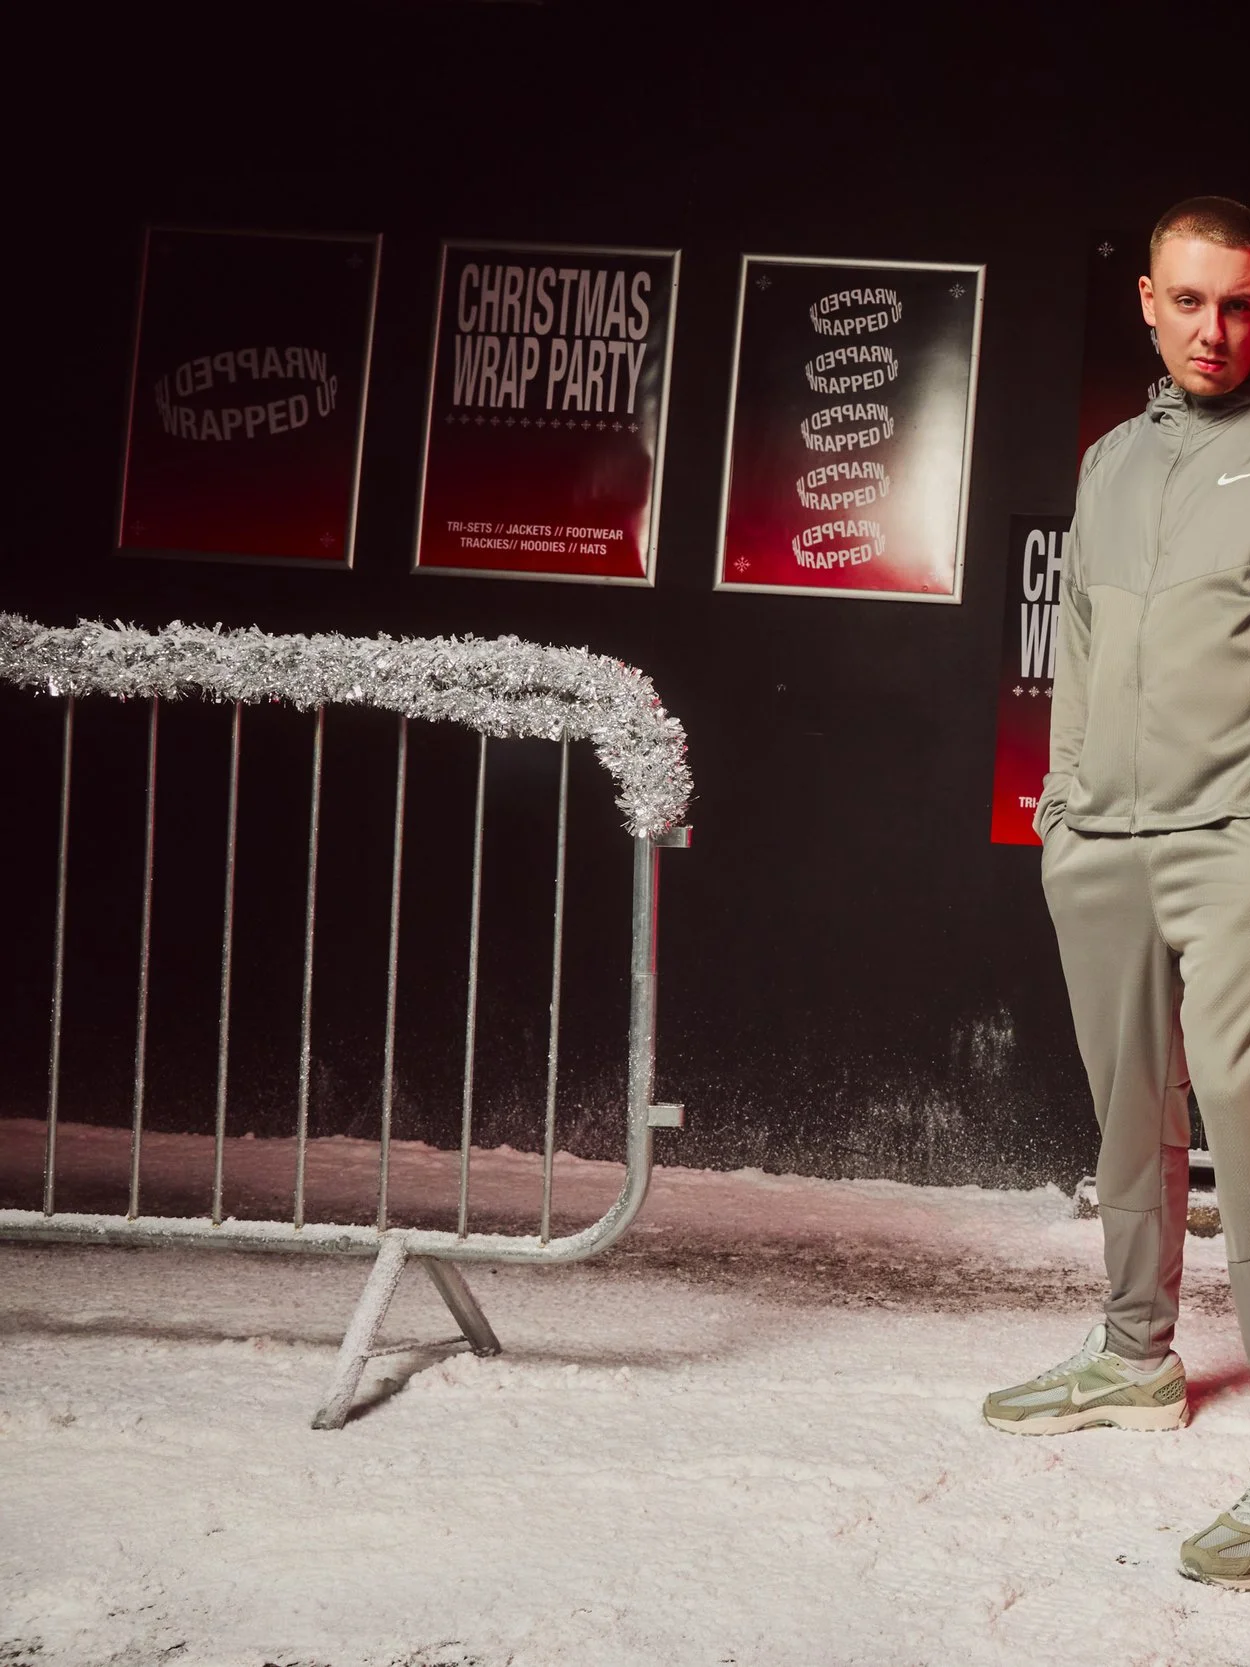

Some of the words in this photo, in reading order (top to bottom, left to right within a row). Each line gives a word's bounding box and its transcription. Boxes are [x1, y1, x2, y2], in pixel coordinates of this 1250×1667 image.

[457, 262, 652, 340] CHRISTMAS
[812, 311, 888, 336] WRAPPED
[891, 301, 902, 323] UP
[453, 333, 540, 409] WRAP
[545, 337, 647, 414] PARTY
[808, 369, 884, 394] WRAPPED
[887, 359, 899, 381] UP
[161, 394, 309, 442] WRAPPED
[316, 374, 338, 417] UP
[804, 427, 880, 452] WRAPPED
[800, 485, 876, 510] WRAPPED
[447, 521, 492, 533] TRI-SETS
[506, 523, 551, 536] JACKETS
[565, 526, 623, 540] FOOTWEAR
[520, 540, 566, 553] HOODIES
[579, 543, 607, 555] HATS
[796, 544, 872, 570] WRAPPED
